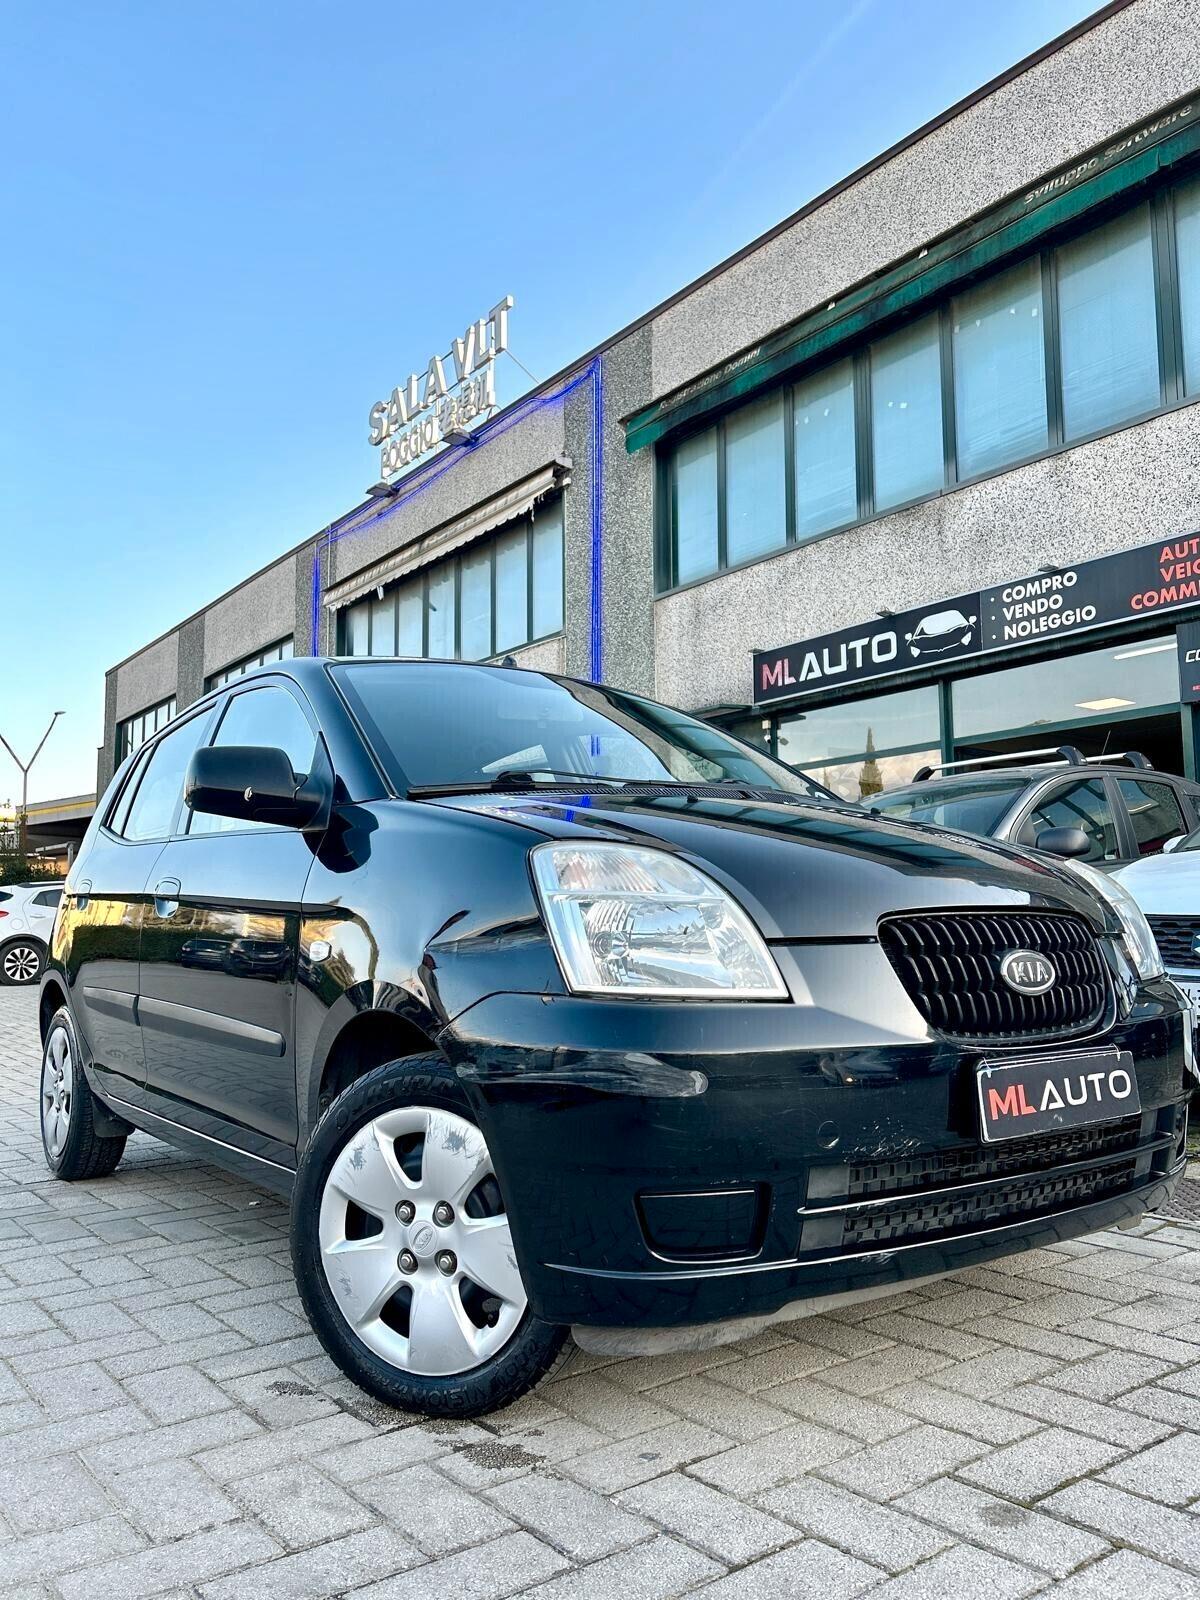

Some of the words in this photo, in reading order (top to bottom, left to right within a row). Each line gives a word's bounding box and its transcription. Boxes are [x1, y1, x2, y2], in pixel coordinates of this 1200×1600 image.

[368, 355, 450, 446] SALA
[451, 295, 514, 382] VLT
[381, 416, 440, 479] POGGIO
[1160, 538, 1200, 563] AUT
[1002, 571, 1078, 603] COMPRO
[1131, 580, 1200, 610] COMM
[1002, 594, 1063, 621] VENDO
[1003, 605, 1097, 641] NOLEGGIO
[761, 658, 796, 690] ML
[799, 631, 898, 682] AUTO
[1011, 961, 1049, 983] KIA
[988, 1084, 1037, 1120] ML
[1040, 1069, 1132, 1112] AUTO
